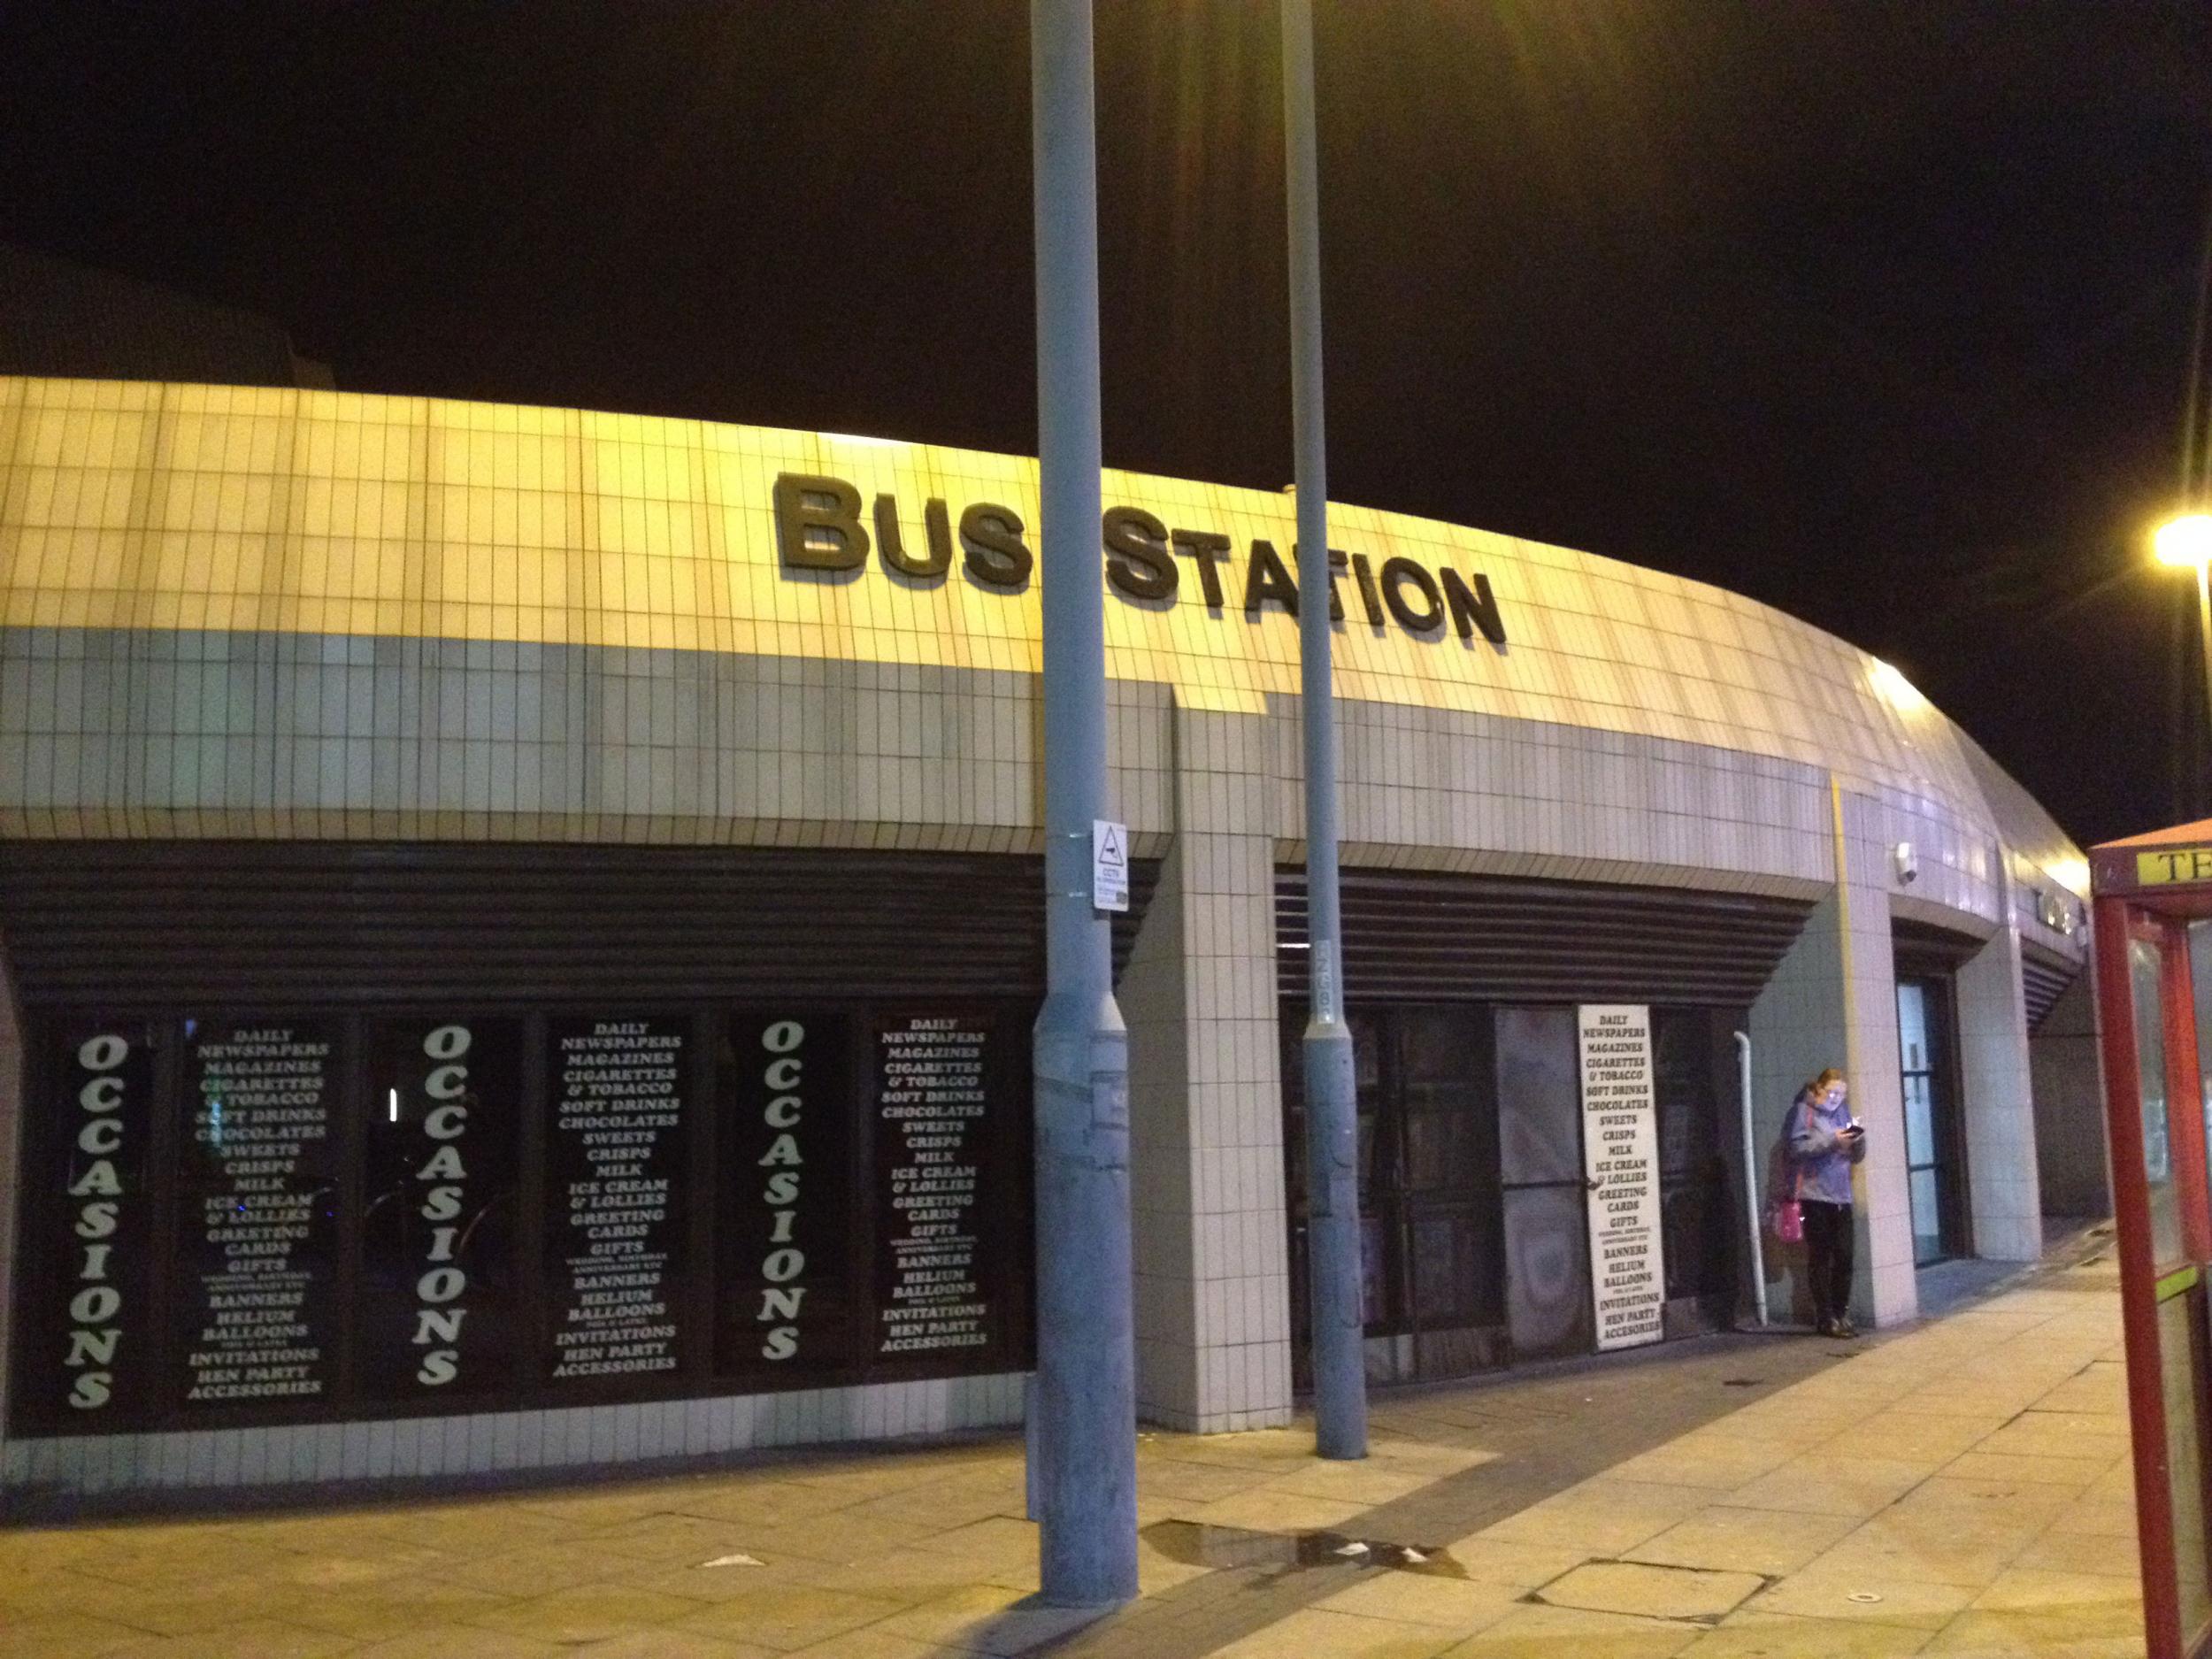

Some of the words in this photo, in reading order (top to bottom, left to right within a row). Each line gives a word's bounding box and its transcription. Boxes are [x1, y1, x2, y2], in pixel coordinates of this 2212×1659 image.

[773, 472, 1033, 587] BUS
[1102, 505, 1508, 645] STATION
[910, 1019, 958, 1030] DAILY
[1600, 1016, 1628, 1025] DAILY
[595, 1024, 649, 1034] DAILY
[1584, 1028, 1645, 1038] NEWSPAPERS
[234, 1031, 294, 1042] DAILY
[561, 1037, 682, 1049] NEWSPAPERS
[882, 1033, 985, 1043] NEWSPAPERS
[197, 1044, 330, 1058] NEWSPAPERS
[887, 1048, 979, 1058] MAGAZINES
[1587, 1043, 1642, 1053] MAGAZINES
[567, 1052, 674, 1065] MAGAZINES
[1586, 1057, 1645, 1068] CIGARETTES
[205, 1061, 321, 1074] MAGAZINES
[885, 1063, 982, 1073] CIGARETTES
[563, 1069, 678, 1081] CIGARETTES
[1589, 1072, 1596, 1081] &
[1600, 1071, 1643, 1080] TOBACCO
[888, 1077, 902, 1087] &
[906, 1077, 979, 1087] TOBACCO
[568, 1085, 582, 1096] &
[588, 1083, 672, 1094] TOBACCO
[1586, 1087, 1609, 1096] SOFT
[1612, 1085, 1647, 1095] DRINKS
[226, 1092, 319, 1105] TOBACCO
[881, 1092, 922, 1103] SOFT
[926, 1091, 985, 1102] DRINKS
[559, 1102, 607, 1113] SOFT
[611, 1098, 680, 1110] DRINKS
[882, 1106, 985, 1118] CHOCOLATES
[1587, 1100, 1647, 1111] CHOCOLATES
[251, 1110, 326, 1122] DRINKS
[559, 1115, 679, 1129] CHOCOLATES
[1600, 1115, 1637, 1125] SWEETS
[902, 1121, 964, 1133] SWEETS
[582, 1132, 657, 1144] SWEETS
[1603, 1130, 1636, 1141] CRISPS
[906, 1137, 962, 1148] CRISPS
[587, 1148, 651, 1161] CRISPS
[1609, 1145, 1632, 1156] MILK
[915, 1152, 955, 1163] MILK
[225, 1161, 296, 1174] CRISPS
[596, 1165, 643, 1177] MILK
[892, 1168, 918, 1179] ICE
[922, 1166, 976, 1178] CREAM
[1596, 1162, 1610, 1172] ICE
[1615, 1160, 1647, 1171] CREAM
[234, 1178, 285, 1191] MILK
[1608, 1172, 1647, 1184] LOLLIES
[569, 1183, 600, 1194] ICE
[605, 1179, 669, 1193] CREAM
[757, 1020, 807, 1360] OCCASIONS
[893, 1182, 906, 1193] &
[910, 1179, 975, 1193] LOLLIES
[1599, 1187, 1647, 1200] GREETING
[245, 1194, 315, 1209] CREAM
[412, 1025, 472, 1385] OCCASIONS
[570, 1197, 586, 1208] &
[590, 1193, 666, 1207] LOLLIES
[893, 1195, 973, 1209] GREETING
[1608, 1201, 1639, 1211] CARDS
[64, 1034, 128, 1409] OCCASIONS
[571, 1210, 665, 1225] GREETING
[908, 1210, 960, 1221] CARDS
[1610, 1217, 1638, 1228] GIFTS
[206, 1226, 309, 1242] GREETING
[588, 1225, 649, 1239] CARDS
[911, 1225, 957, 1237] GIFTS
[225, 1242, 291, 1256] CARDS
[591, 1241, 645, 1255] GIFTS
[1604, 1245, 1647, 1259] BANNERS
[227, 1258, 287, 1272] GIFTS
[898, 1254, 972, 1268] BANNERS
[574, 1273, 661, 1288] BANNERS
[903, 1271, 964, 1283] HELIUM
[1604, 1272, 1652, 1287] BALLOONS
[894, 1282, 976, 1298] BALLOONS
[210, 1293, 303, 1307] BANNERS
[580, 1290, 653, 1304] HELIUM
[1600, 1293, 1659, 1310] INVITATIONS
[217, 1310, 296, 1325] HELIUM
[568, 1302, 665, 1320] BALLOONS
[883, 1304, 987, 1321] INVITATIONS
[1605, 1313, 1624, 1325] HEN
[1627, 1309, 1655, 1321] PARTY
[203, 1325, 309, 1340] BALLOONS
[556, 1325, 676, 1346] INVITATIONS
[890, 1325, 924, 1337] HEN
[928, 1321, 979, 1333] PARTY
[881, 1333, 987, 1352] ACCESSORIES
[188, 1348, 320, 1366] INVITATIONS
[564, 1348, 603, 1361] HEN
[609, 1342, 667, 1357] PARTY
[553, 1357, 677, 1377] ACCESSORIES
[197, 1370, 240, 1382] HEN
[245, 1366, 310, 1380] PARTY
[188, 1381, 321, 1399] ACCESSORIES
